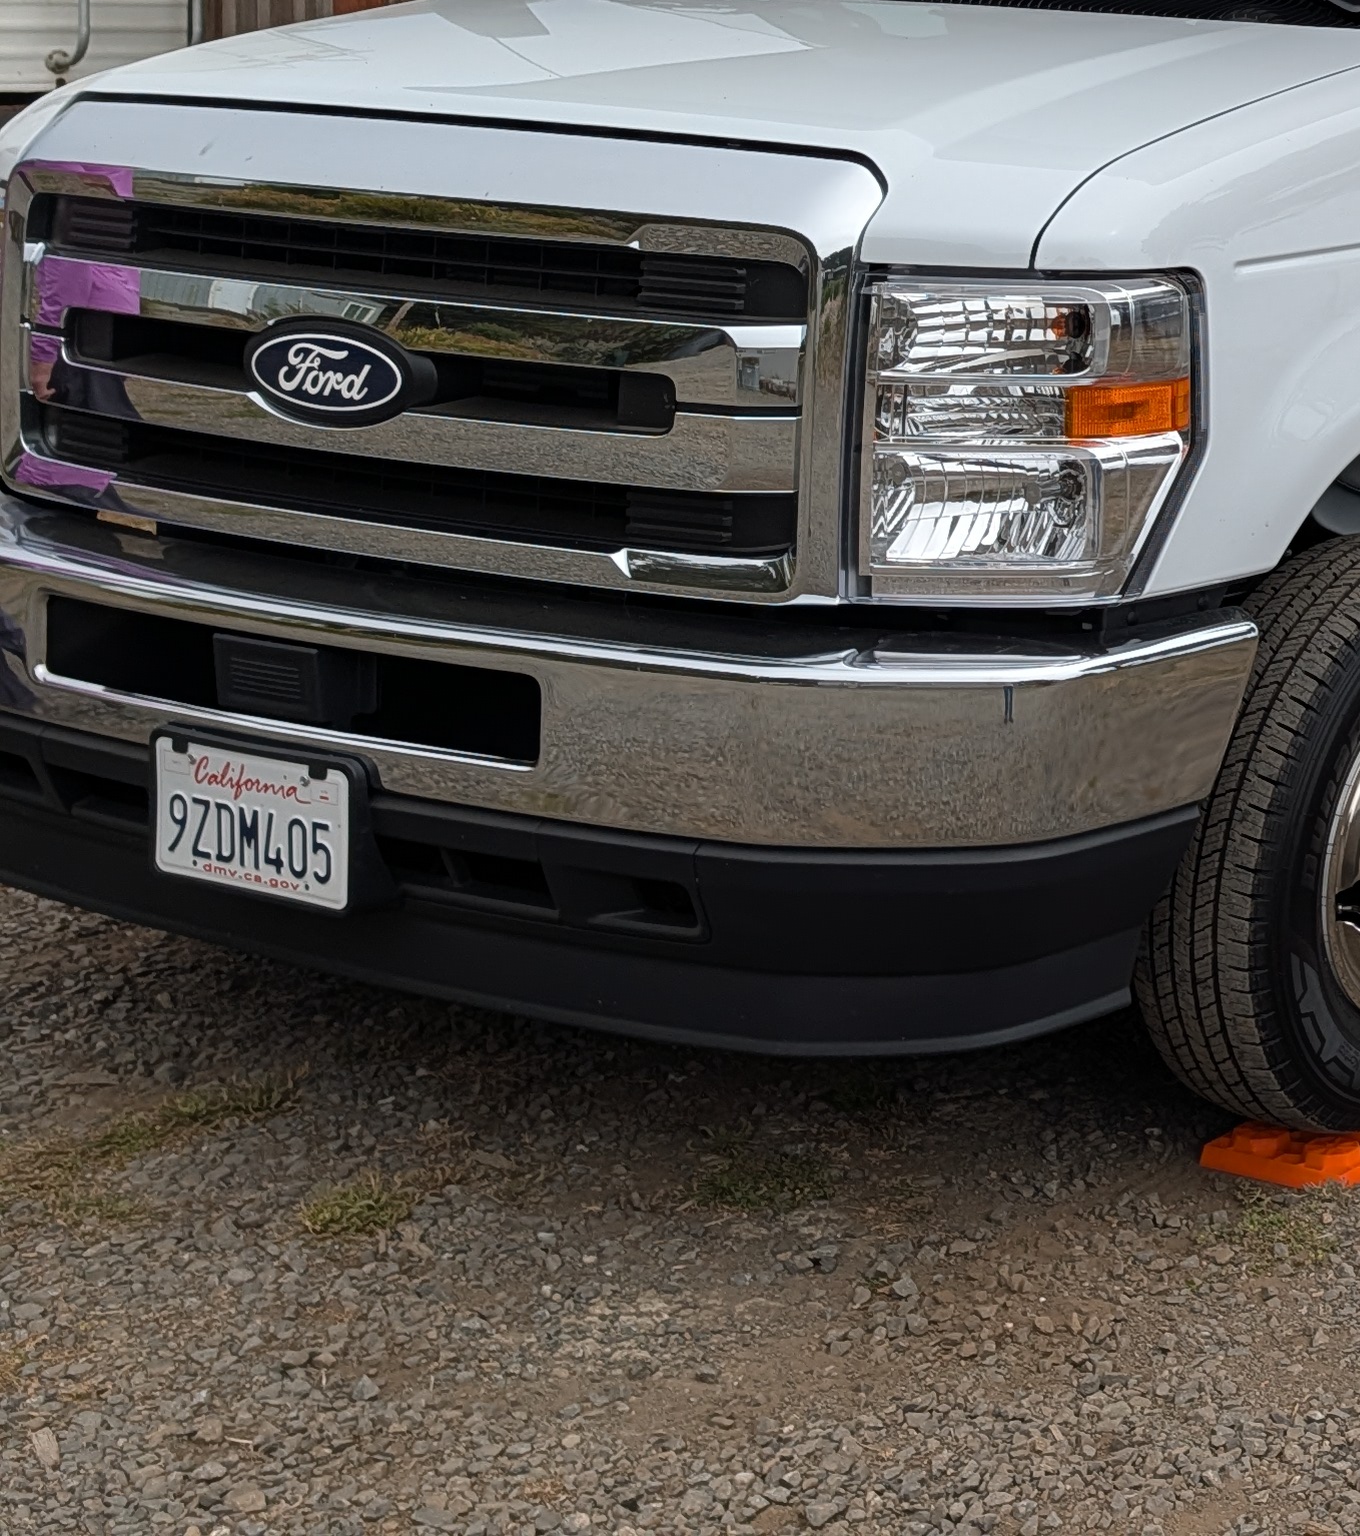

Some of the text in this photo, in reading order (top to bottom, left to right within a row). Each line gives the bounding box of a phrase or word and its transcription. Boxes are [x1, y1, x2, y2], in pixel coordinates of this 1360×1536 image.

[277, 342, 373, 402] Ford
[193, 755, 312, 802] California
[167, 793, 332, 886] 9ZDM405
[202, 861, 301, 892] dmv.ca.gov
